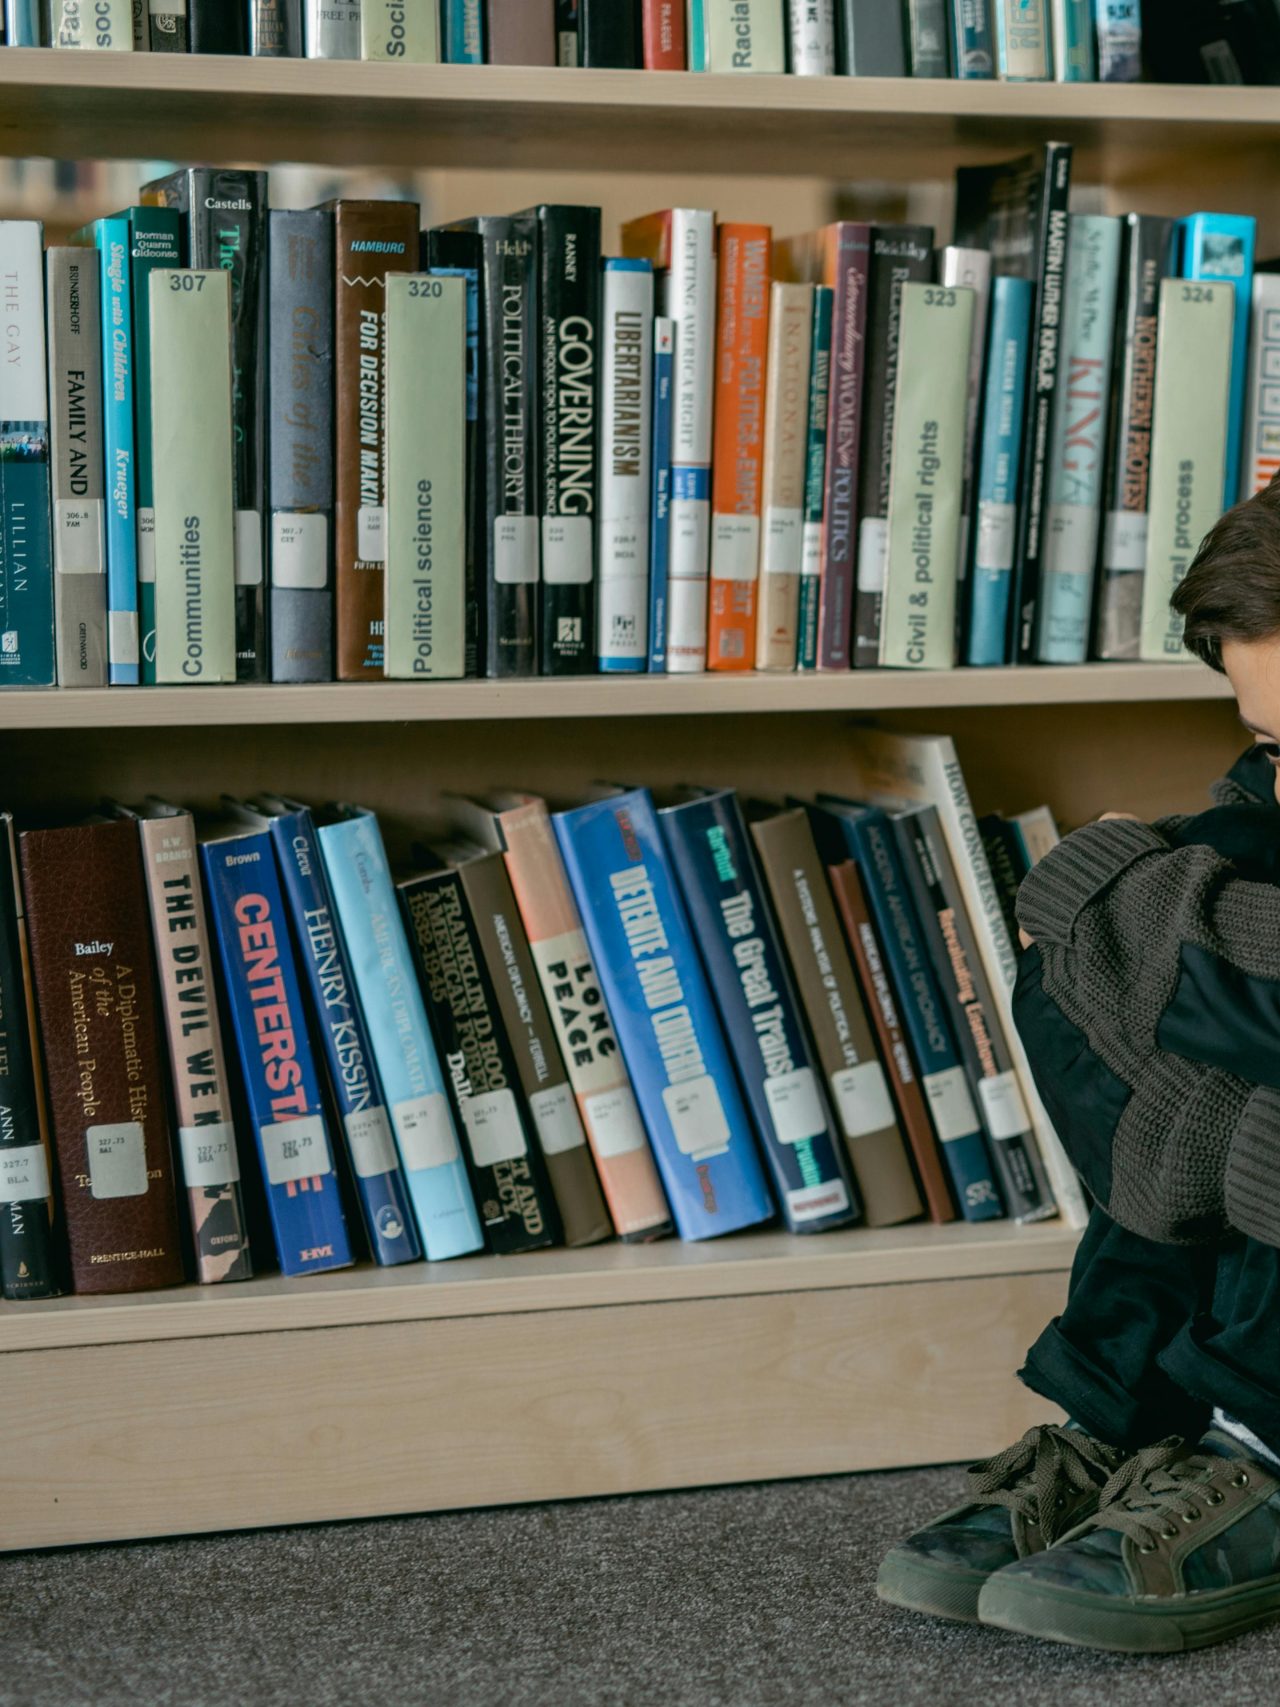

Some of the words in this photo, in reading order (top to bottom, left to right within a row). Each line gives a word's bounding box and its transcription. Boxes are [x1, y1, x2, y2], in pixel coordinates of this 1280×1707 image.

[204, 197, 252, 210] Castells
[110, 242, 123, 292] Single
[135, 231, 174, 241] Borman
[219, 224, 241, 270] The
[350, 240, 405, 254] HAMBURG
[564, 233, 577, 282] RANNEY
[1045, 210, 1066, 272] MARTIN
[5, 271, 19, 312] THE
[170, 274, 206, 291] 307
[408, 281, 442, 297] 320
[684, 228, 699, 307] GETTING
[743, 239, 767, 319] WOMEN
[924, 289, 956, 306] 323
[1182, 286, 1214, 303] 324
[69, 265, 81, 335] BRINKERHOFF
[359, 309, 378, 350] FOR
[1041, 273, 1061, 327] LUTHER
[7, 323, 22, 368] GAY
[112, 328, 127, 402] Children
[502, 285, 524, 399] POLITICAL
[543, 337, 556, 408] INTRODUCTION
[682, 311, 697, 386] AMERICA
[1127, 315, 1157, 428] NORTHERN
[67, 369, 87, 443] FAMILY
[359, 352, 378, 446] DECISION
[558, 316, 594, 514] GOVERNING
[612, 310, 642, 477] LIBERTARIANISM
[680, 392, 694, 448] RIGHT
[737, 355, 762, 444] POLITICS
[837, 371, 857, 451] WOMEN
[1064, 356, 1104, 472] KING
[69, 448, 88, 496] AND
[504, 407, 526, 495] THEORY
[545, 426, 557, 475] POLITICAL
[916, 420, 941, 486] rights
[113, 447, 129, 519] Krueger
[545, 477, 557, 514] SCIENCE
[1174, 458, 1195, 549] process
[412, 478, 433, 572] science
[831, 468, 851, 562] POLITICS
[911, 491, 935, 584] political
[11, 502, 28, 592] LILLIAN
[179, 515, 203, 677] Communities
[412, 578, 433, 673] Political
[910, 590, 929, 608] &
[79, 621, 87, 670] GREENWOOD
[906, 613, 927, 664] Civil
[155, 848, 193, 864] BRANDS
[225, 851, 261, 867] Brown
[292, 835, 312, 877] Cleva
[957, 812, 997, 912] CONGRESS
[163, 874, 196, 933] THE
[720, 889, 754, 938] The
[75, 941, 114, 957] Bailey
[93, 967, 110, 990] of
[115, 964, 133, 980] A
[303, 905, 350, 1010] HENRY
[407, 893, 449, 1005] 1932-1945
[422, 890, 466, 1014] AMERICAN
[732, 936, 779, 1008] Great
[68, 970, 90, 1055] American
[95, 992, 110, 1017] the
[172, 946, 209, 1037] DEVIL
[506, 963, 534, 1033] DIPLOMACY
[574, 962, 616, 1058] LONG
[635, 954, 684, 1011] AND
[826, 989, 850, 1037] POLITICAL
[115, 981, 142, 1081] Diplomatic
[547, 960, 595, 1068] PEACE
[77, 1058, 96, 1118] People
[185, 1048, 218, 1098] WE
[438, 882, 484, 1009] FRANKLIN
[516, 1185, 544, 1236] AND
[0, 1104, 15, 1141] ANN
[90, 1248, 166, 1264] PRENTICE-HALL
[210, 1234, 240, 1245] OXFORD
